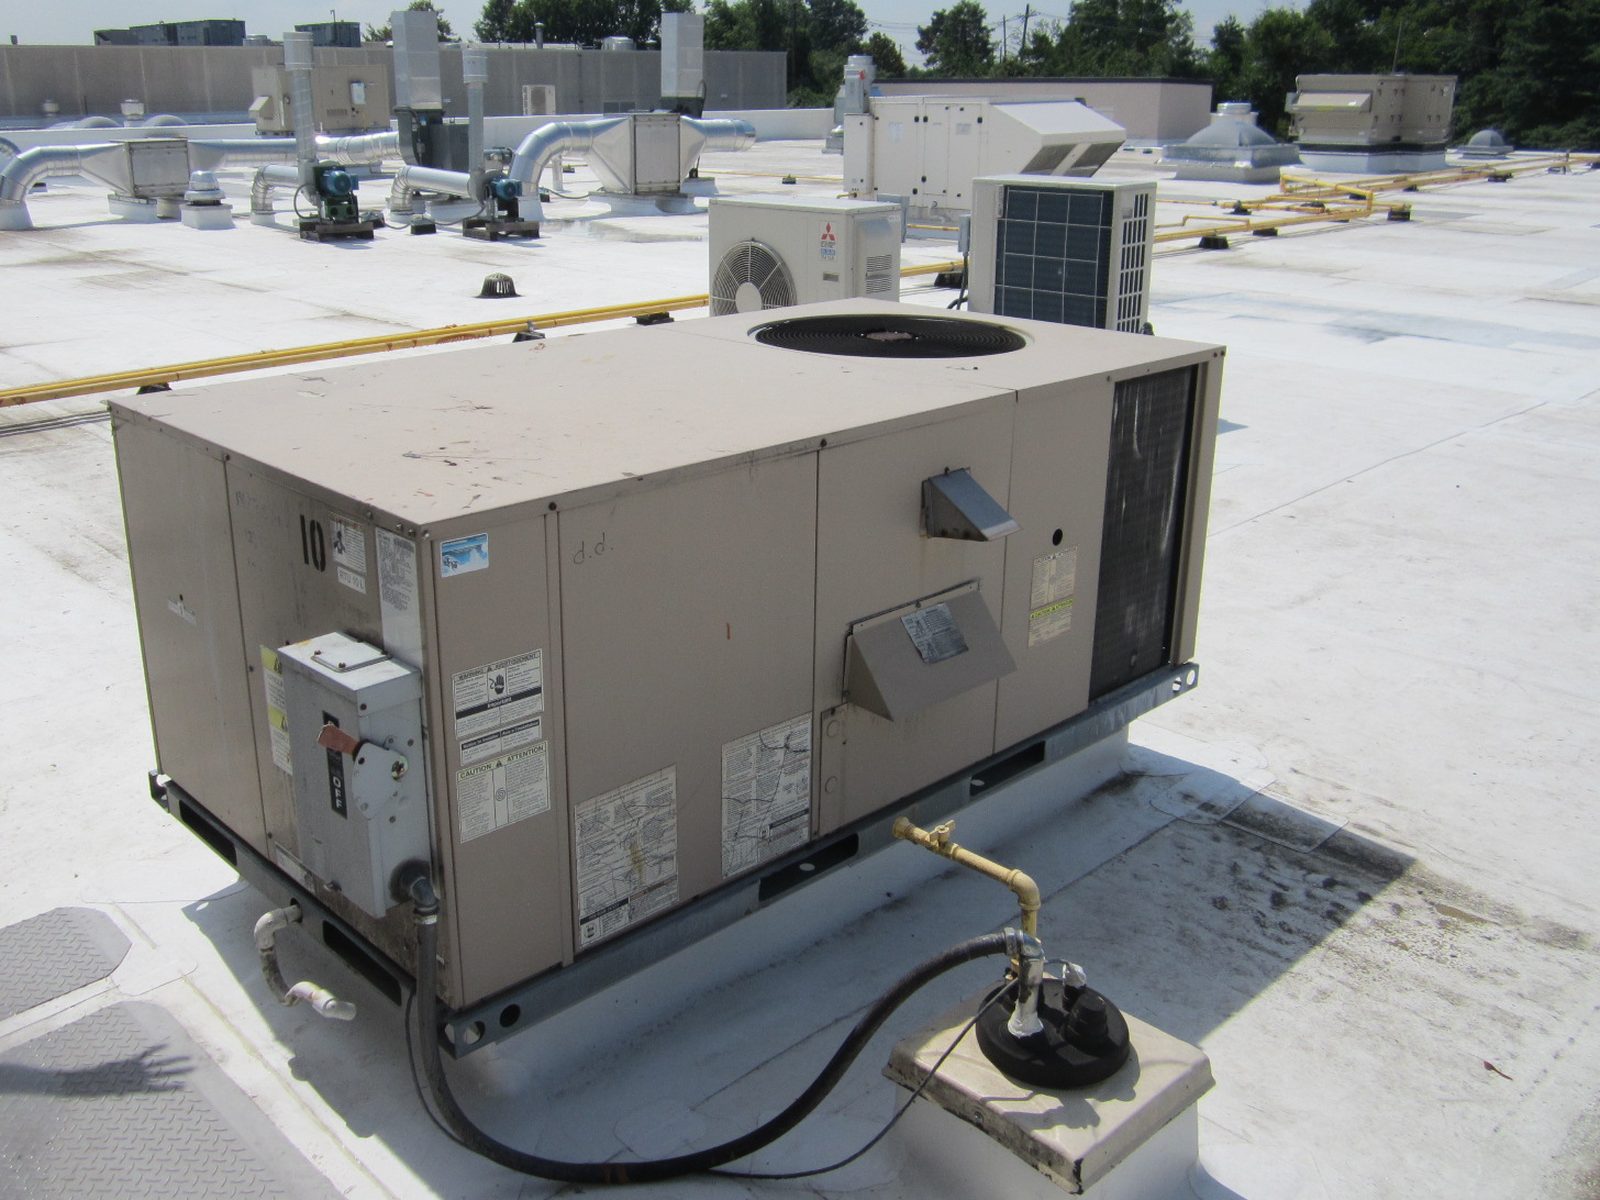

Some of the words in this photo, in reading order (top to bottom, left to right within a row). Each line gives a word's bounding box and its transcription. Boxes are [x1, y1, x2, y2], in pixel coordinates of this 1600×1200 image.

[300, 514, 326, 572] 10
[460, 763, 492, 779] CAUTION
[507, 745, 544, 762] ATTENTION
[333, 776, 342, 808] OFF
